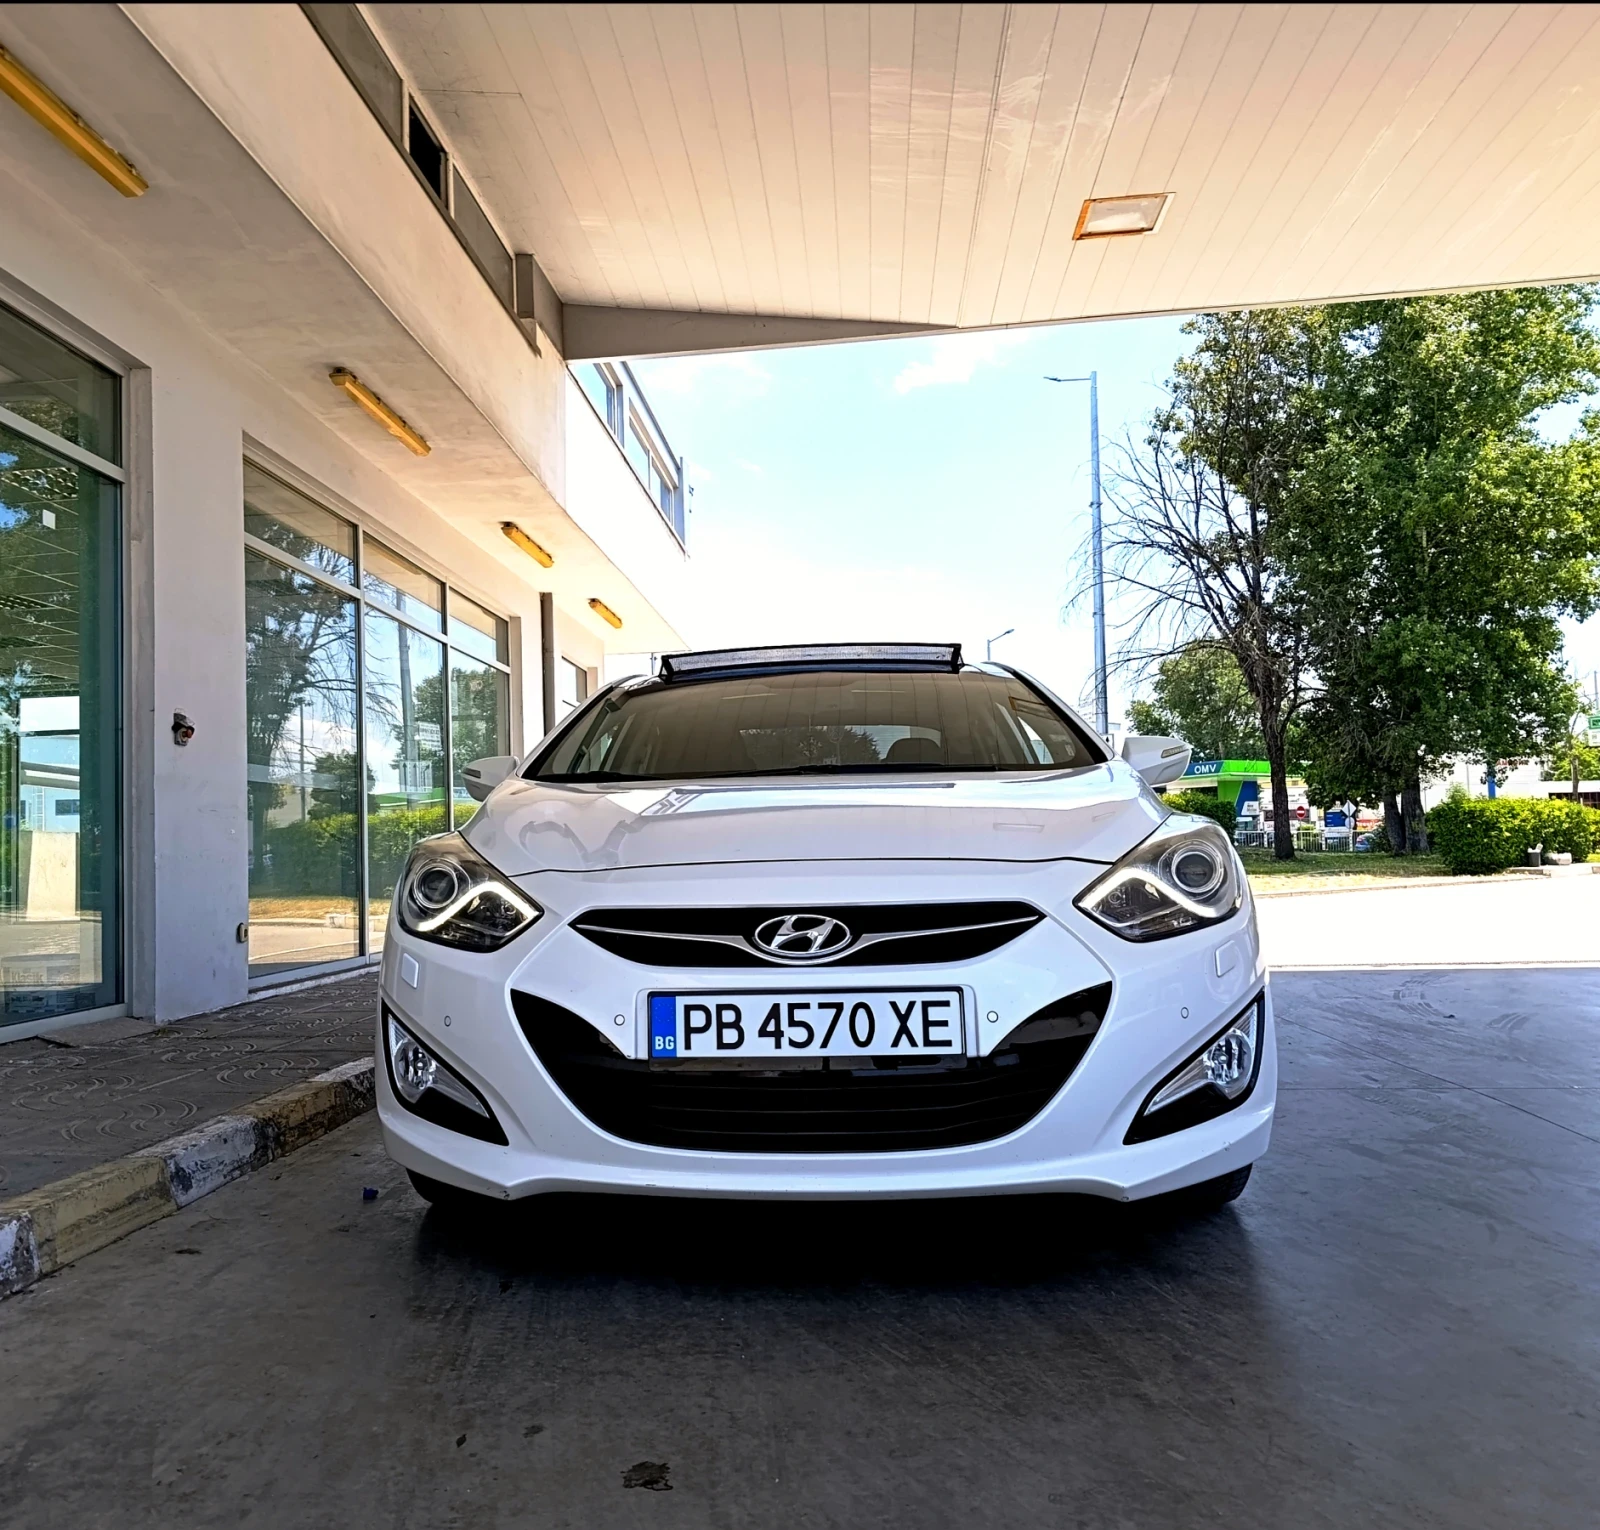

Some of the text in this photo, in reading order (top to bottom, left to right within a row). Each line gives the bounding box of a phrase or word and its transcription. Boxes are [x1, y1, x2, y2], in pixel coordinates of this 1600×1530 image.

[1194, 764, 1217, 774] OMV
[683, 1000, 953, 1050] PB 4570 XE
[655, 1036, 675, 1050] BG
